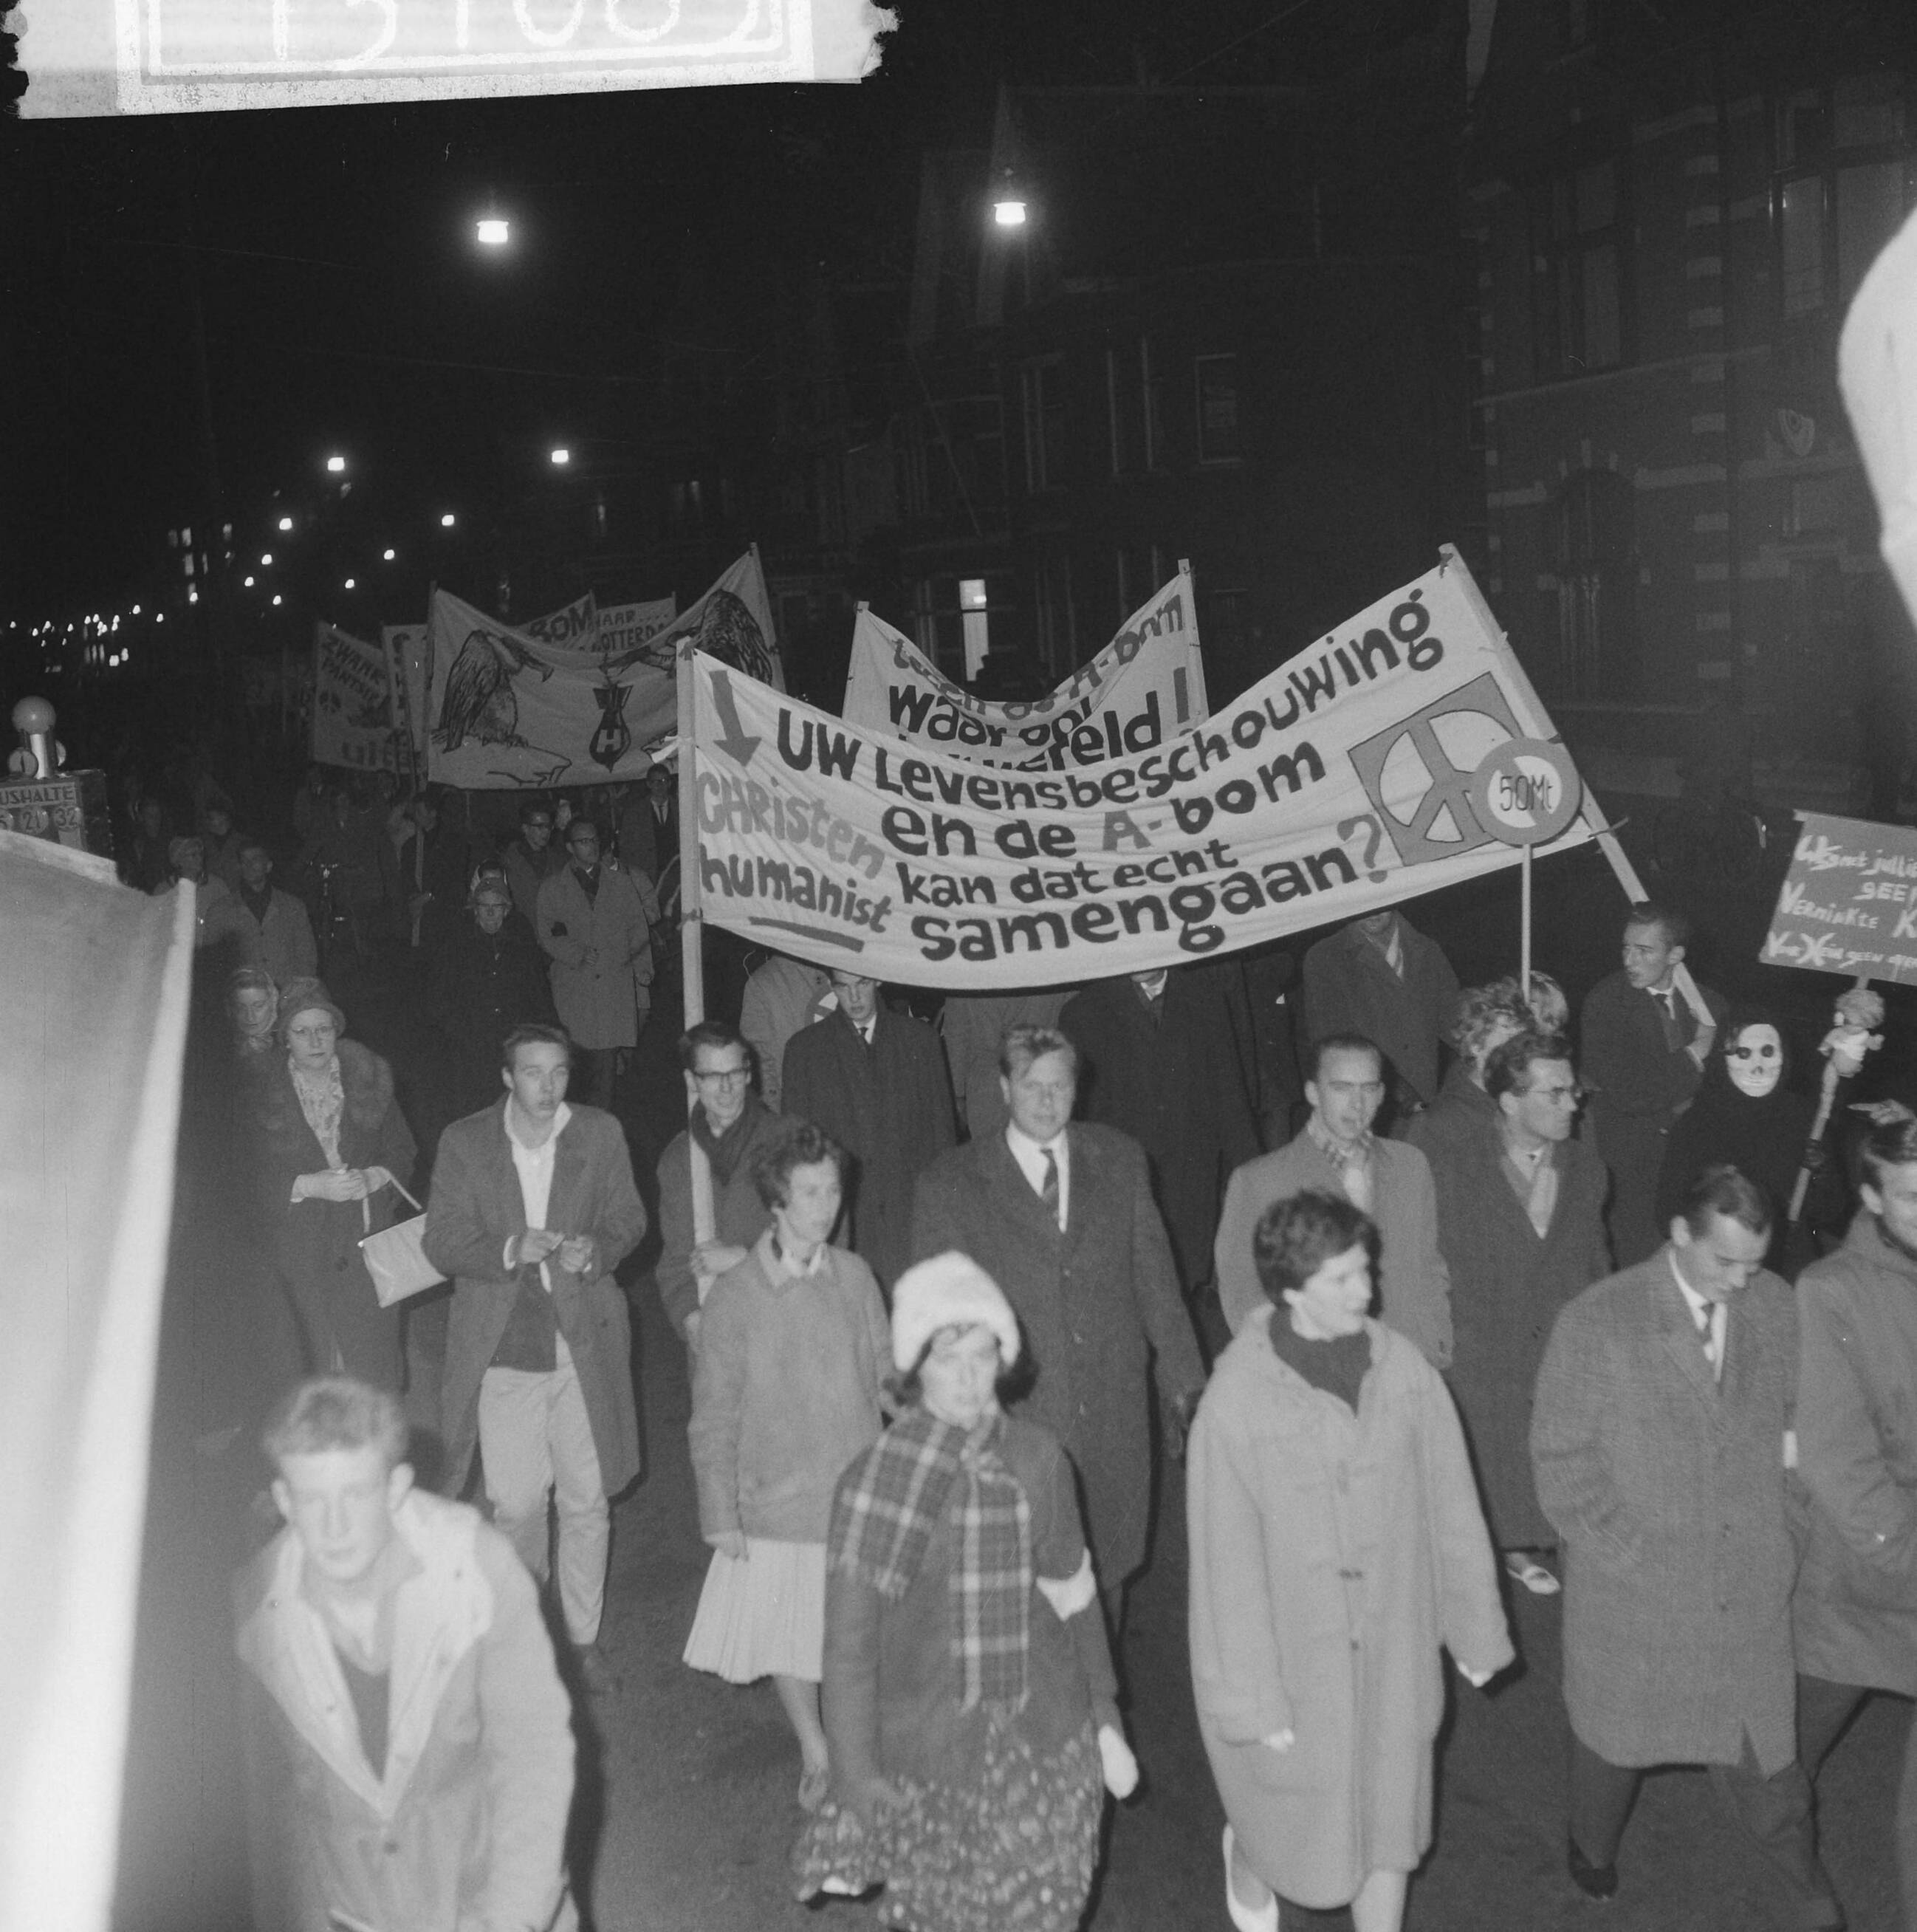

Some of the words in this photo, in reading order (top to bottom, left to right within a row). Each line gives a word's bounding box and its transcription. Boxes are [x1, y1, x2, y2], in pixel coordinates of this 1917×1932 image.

[778, 708, 862, 781] UW
[876, 589, 1444, 810] Levensbeschouwing
[55, 807, 78, 826] 32
[882, 805, 977, 857] en
[994, 819, 1077, 859] de
[1103, 741, 1326, 853] A-bom
[700, 843, 892, 933] humanist
[896, 862, 997, 907] kan
[1009, 862, 1109, 902] dat
[1112, 839, 1238, 888] echt
[911, 813, 1384, 961] samengaan?
